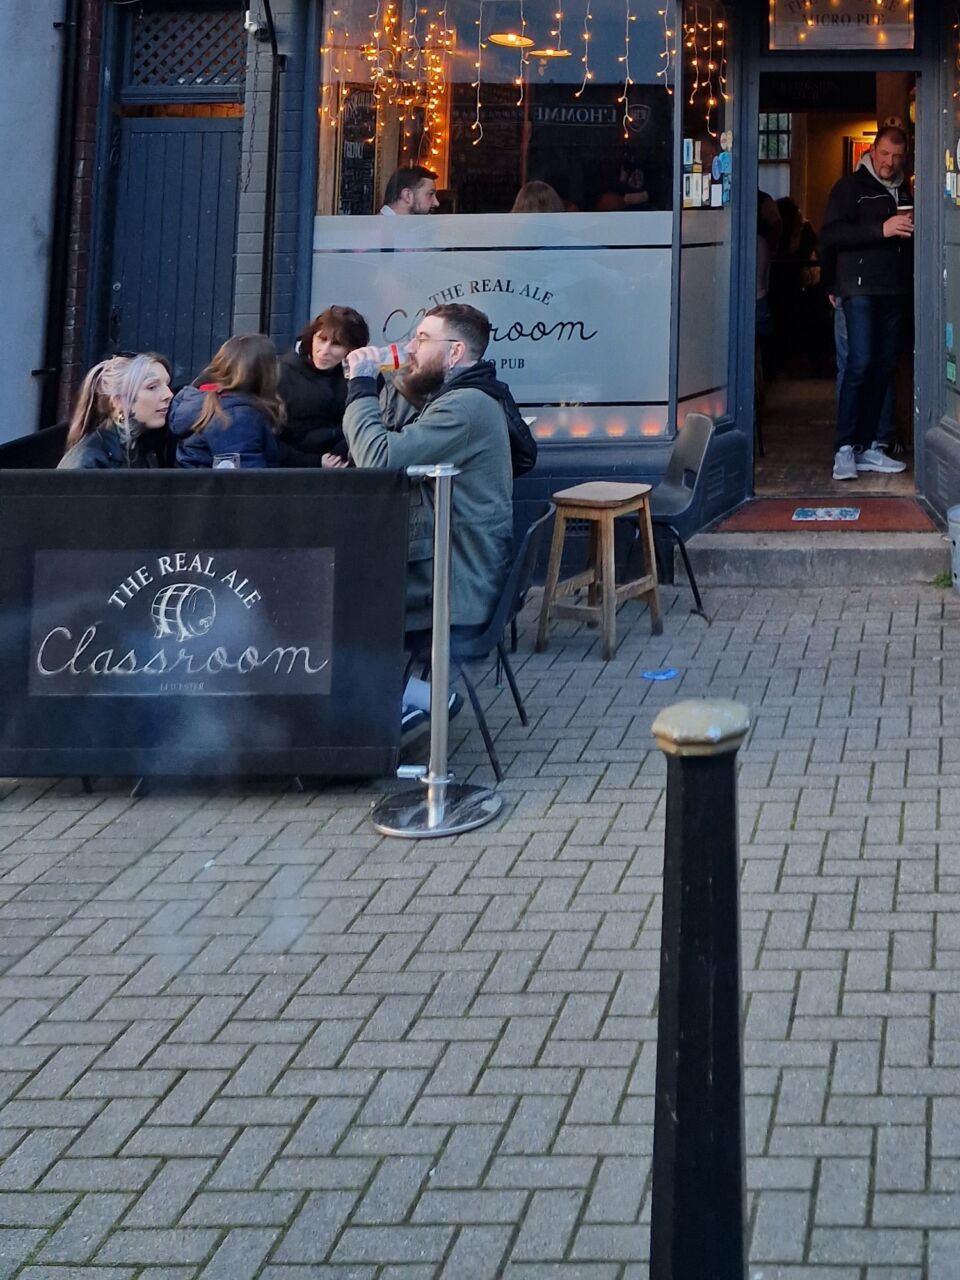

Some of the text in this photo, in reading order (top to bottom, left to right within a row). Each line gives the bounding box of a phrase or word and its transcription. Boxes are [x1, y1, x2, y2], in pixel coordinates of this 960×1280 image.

[428, 279, 553, 306] THE REAL ALE
[383, 307, 598, 343] Clroom
[501, 358, 525, 369] PUB
[108, 552, 262, 610] THE REAL ALE
[36, 625, 329, 676] Classroom
